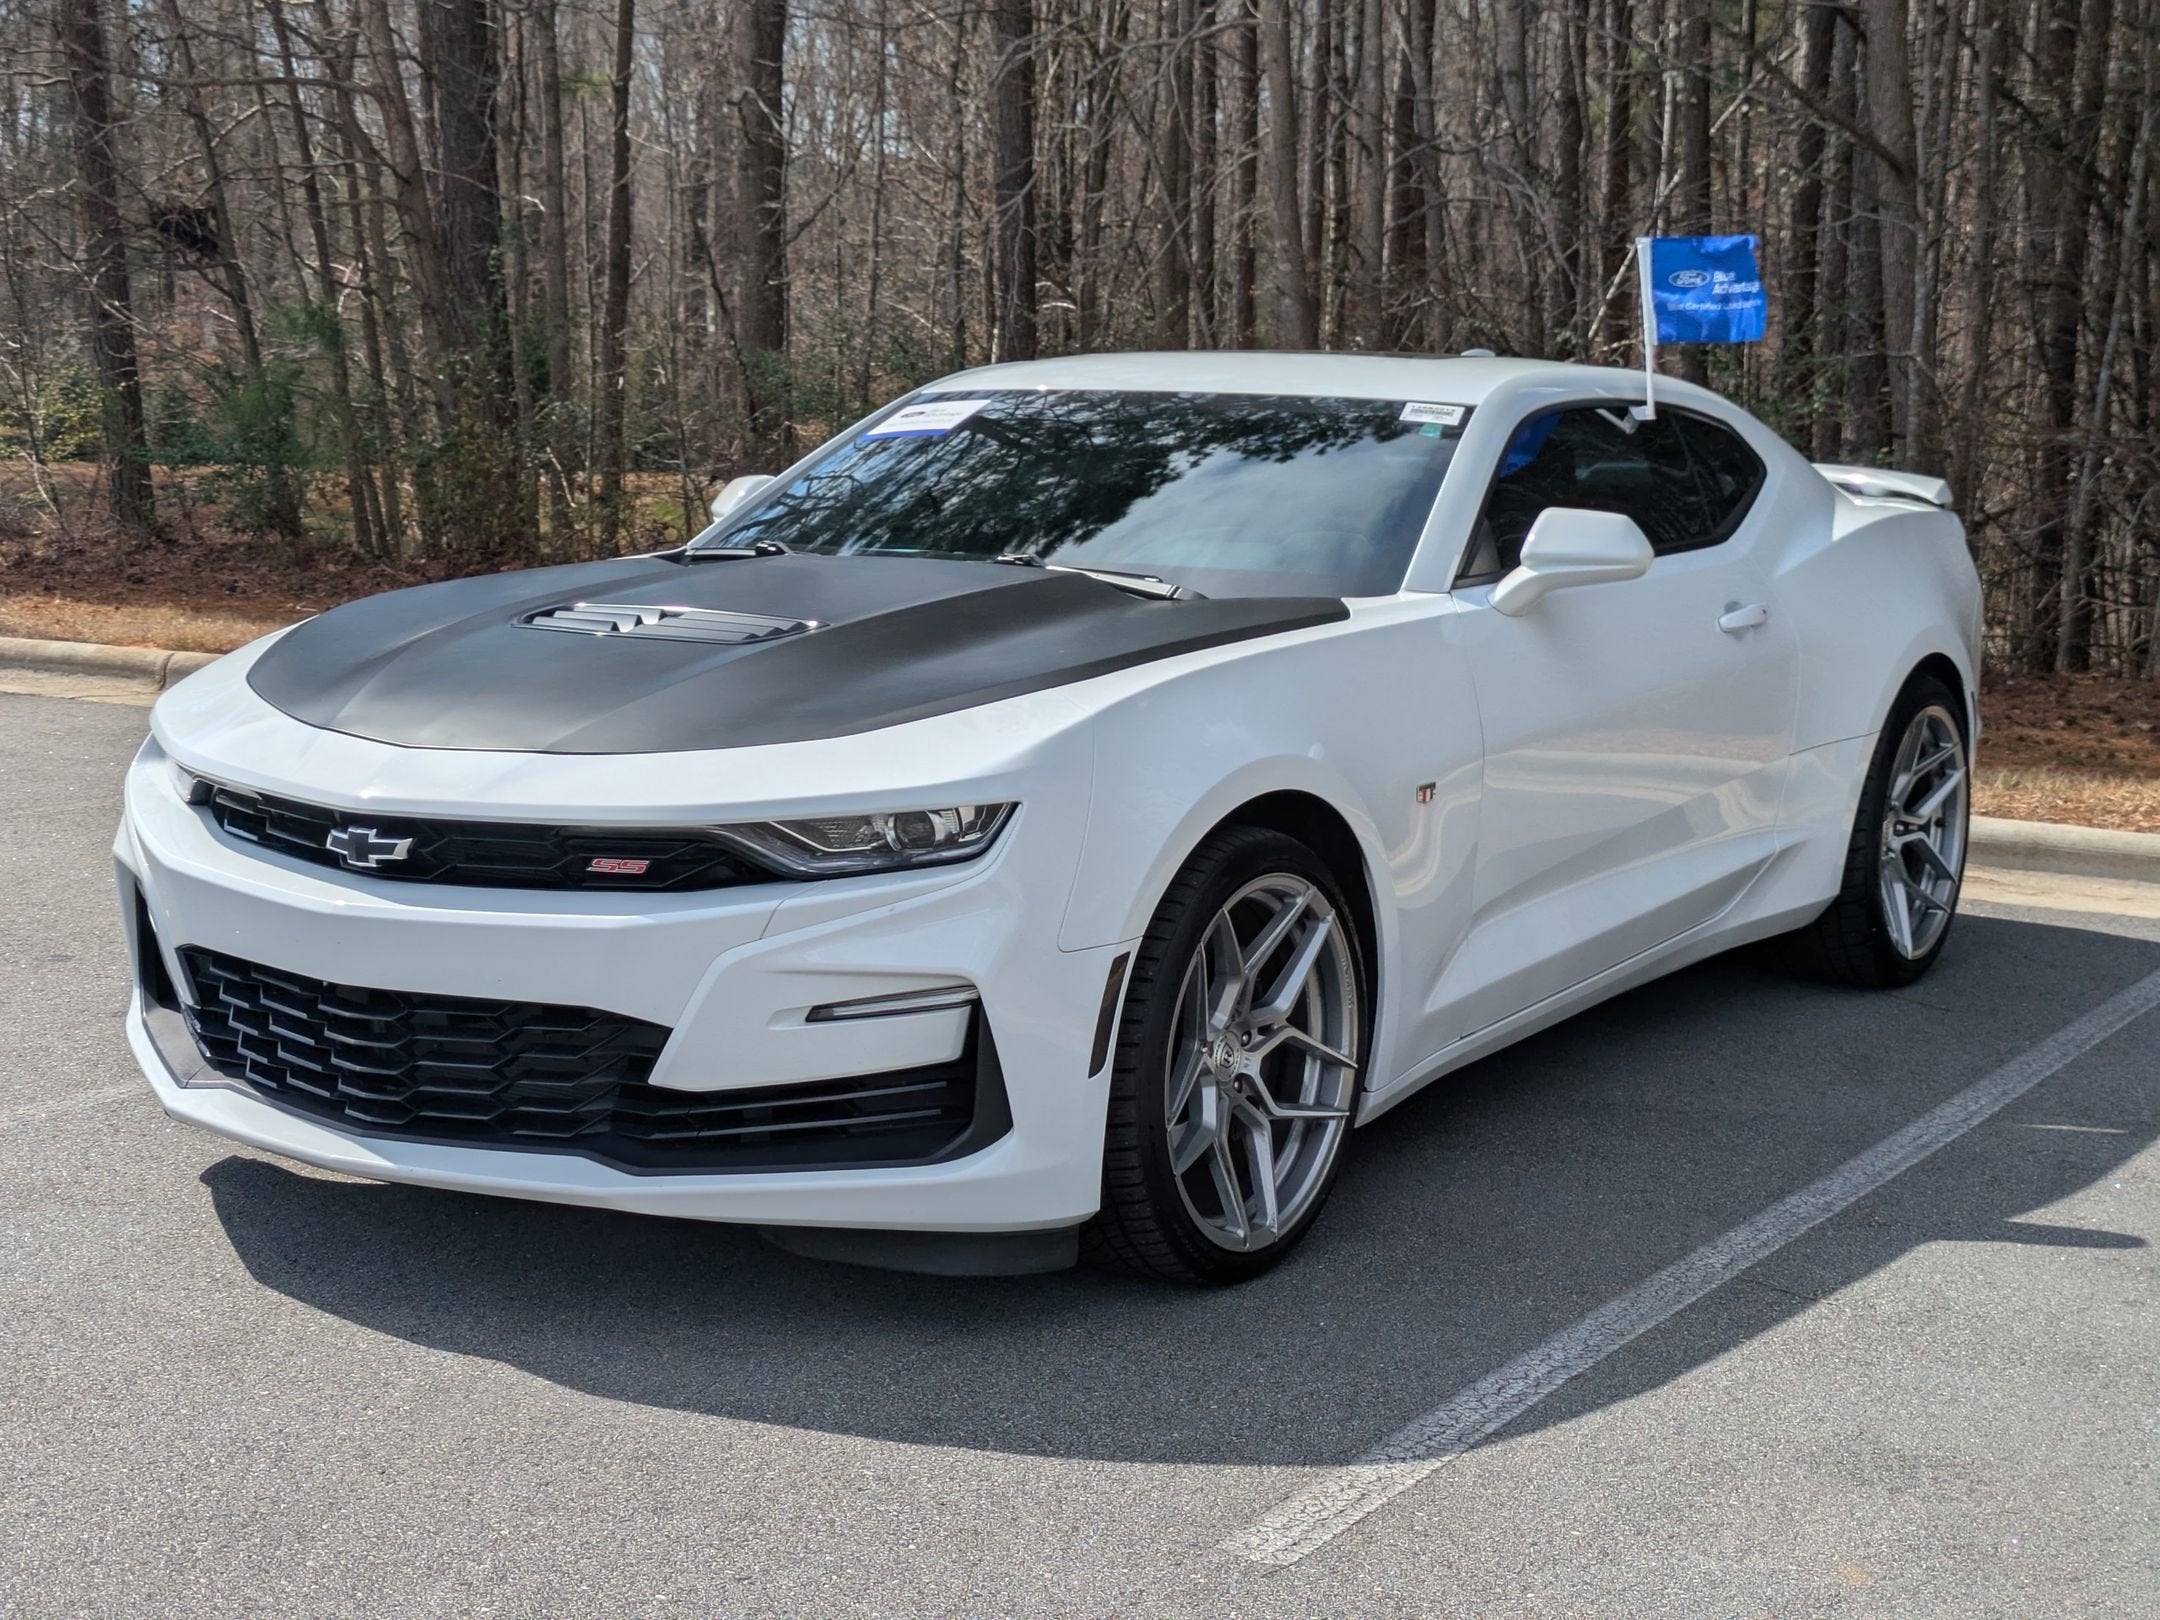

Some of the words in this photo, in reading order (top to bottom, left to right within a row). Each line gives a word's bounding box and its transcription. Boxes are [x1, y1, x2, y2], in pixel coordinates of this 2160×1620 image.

[1675, 271, 1703, 285] Ford
[1713, 271, 1736, 283] Blue
[585, 858, 650, 874] SS
